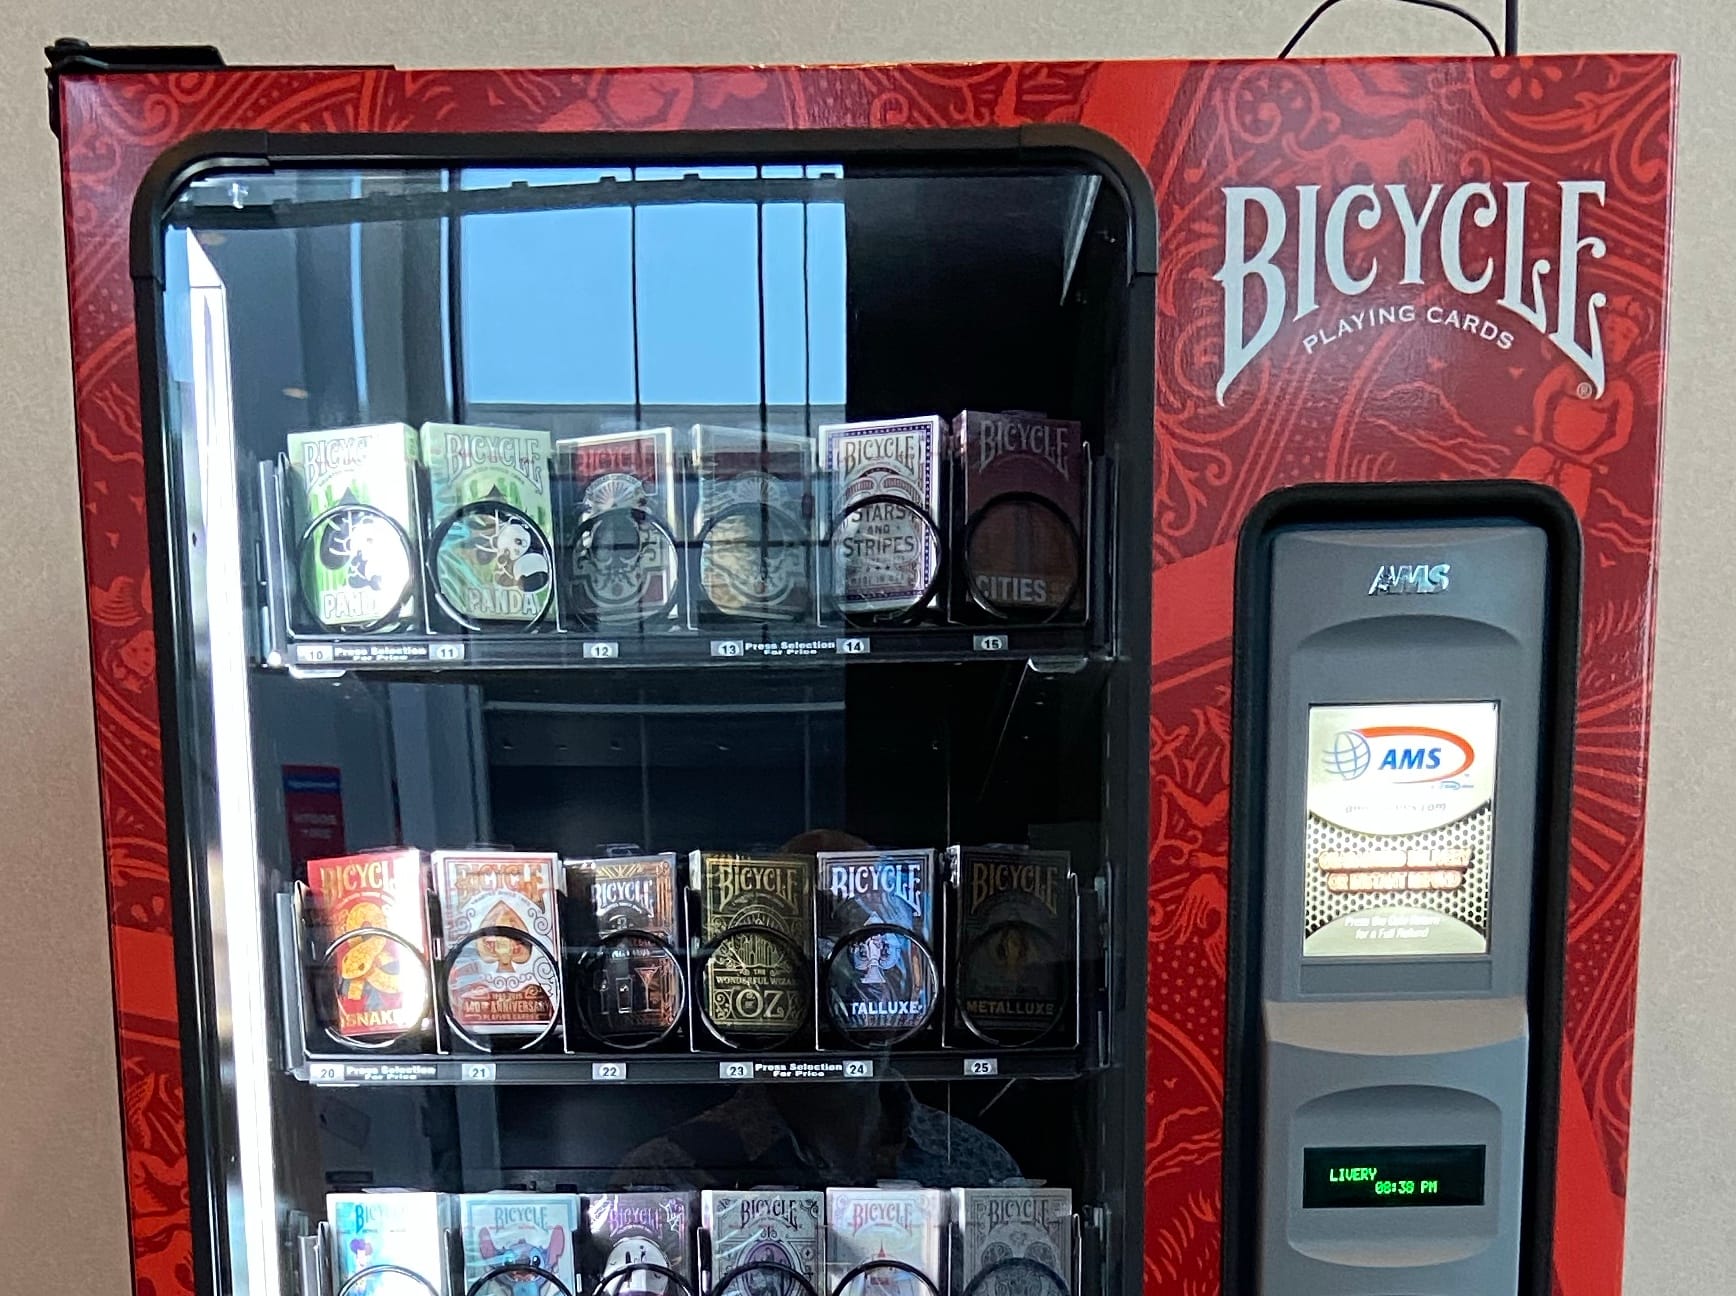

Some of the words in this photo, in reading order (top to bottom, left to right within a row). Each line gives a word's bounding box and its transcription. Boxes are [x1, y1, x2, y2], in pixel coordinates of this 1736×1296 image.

[1212, 180, 1607, 407] BICYCLE
[1302, 305, 1416, 354] PLAYING
[1427, 307, 1514, 350] CARDS
[844, 435, 915, 479] BICYCLE
[978, 417, 1070, 480] BICYCLE
[445, 432, 543, 495] BICYCLE
[867, 524, 891, 535] AND
[843, 536, 914, 557] STRIPES
[978, 575, 1048, 602] CITIES
[467, 587, 538, 616] PANDA
[441, 648, 453, 657] 11
[594, 645, 608, 657] 12
[721, 645, 736, 655] 13
[745, 643, 777, 651] Press
[781, 641, 835, 650] Selection
[845, 641, 860, 651] 14
[984, 638, 999, 650] 15
[1378, 747, 1442, 771] AMS
[454, 862, 546, 914] BICYCLE
[718, 862, 799, 912] BICYCLE
[831, 864, 921, 917] BICYCLE
[970, 863, 1057, 915] BICYCLE
[736, 989, 785, 1017] OZ
[966, 1001, 1054, 1015] METALLUXE
[473, 1068, 485, 1077] 21
[603, 1066, 617, 1077] 22
[730, 1066, 744, 1076] 23
[755, 1063, 787, 1071] Press
[790, 1062, 842, 1071] Selection
[850, 1065, 863, 1075] 24
[974, 1062, 989, 1074] 25
[1330, 1168, 1377, 1182] LIVERY
[494, 1205, 549, 1232] BICYCLE
[740, 1200, 798, 1231] BICYCLE
[853, 1202, 913, 1237] BICYCLE
[988, 1200, 1050, 1233] BICYCLE
